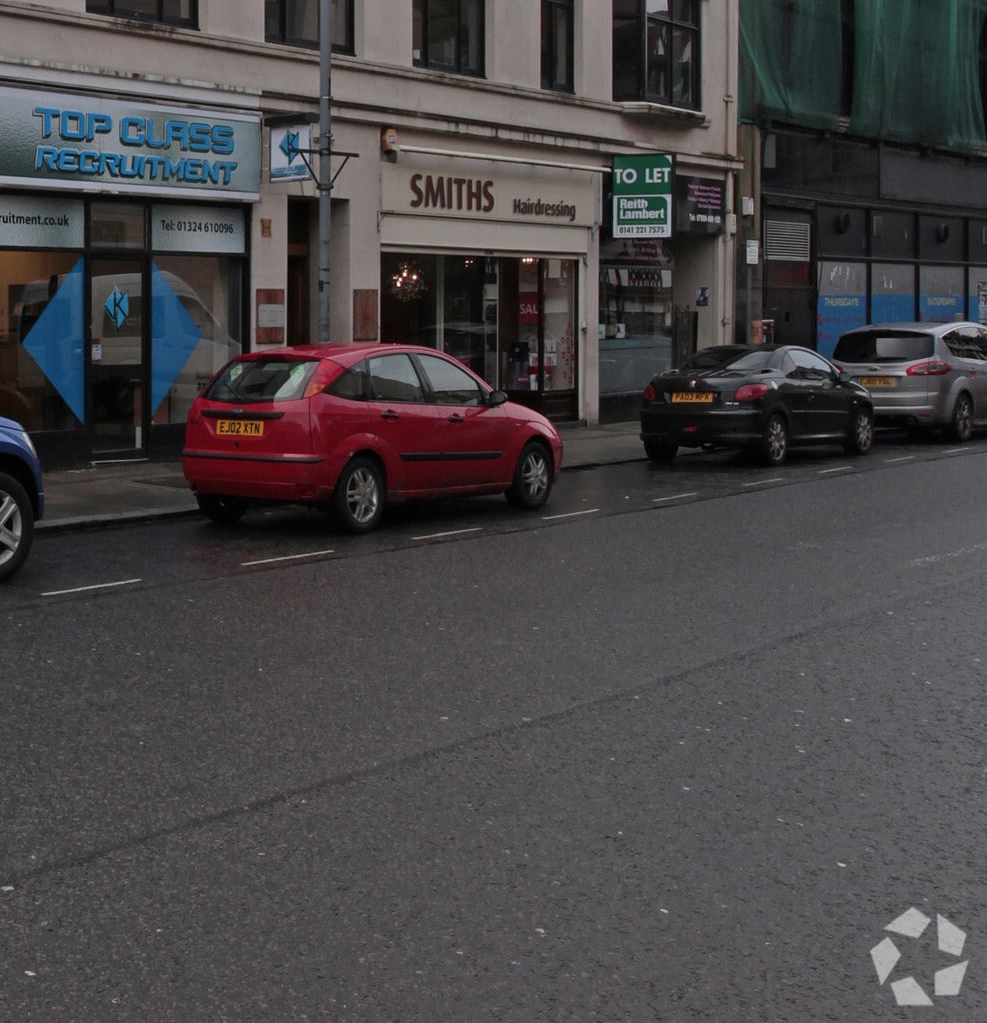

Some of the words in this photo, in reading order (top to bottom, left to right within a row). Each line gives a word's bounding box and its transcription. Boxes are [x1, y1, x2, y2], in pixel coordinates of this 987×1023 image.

[32, 106, 113, 142] TOP
[119, 115, 235, 156] CLASS
[34, 145, 238, 185] RECRUITMENT
[614, 168, 638, 184] TO
[645, 167, 671, 184] LET
[410, 173, 495, 213] SMITHS
[513, 198, 577, 222] Hairdressing
[619, 198, 648, 209] Reith
[619, 208, 664, 220] Lambert
[161, 219, 176, 231] Tel:
[176, 220, 202, 233] 01324
[202, 221, 234, 234] 610096
[618, 226, 634, 234] 0141
[635, 226, 647, 234] 221
[648, 226, 665, 234] 7575
[824, 297, 859, 307] THURSDAYS
[219, 422, 241, 433] EJ02
[243, 422, 260, 434] XTN
